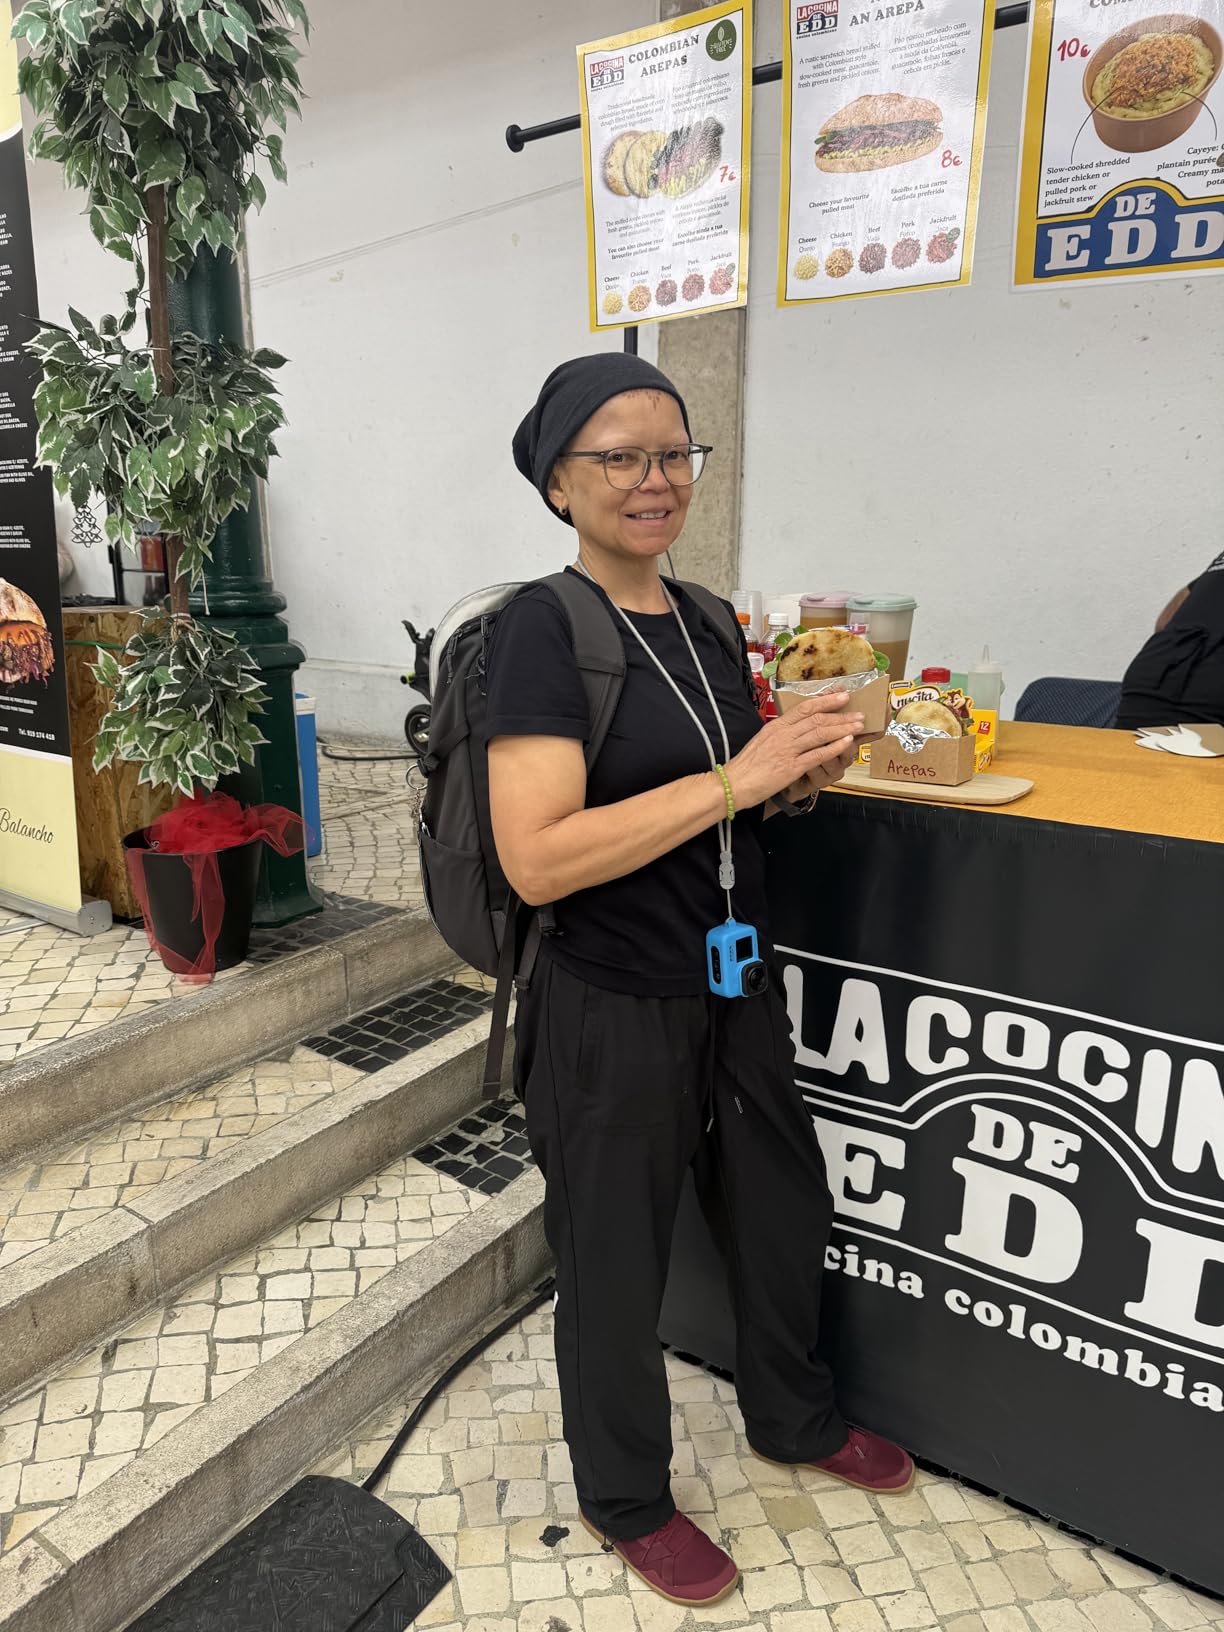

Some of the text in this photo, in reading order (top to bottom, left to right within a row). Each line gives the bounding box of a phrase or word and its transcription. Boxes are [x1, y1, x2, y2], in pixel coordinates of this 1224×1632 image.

[850, 0, 924, 27] AN AREPA
[629, 35, 699, 63] COLOMBIAN
[641, 55, 688, 77] AREPAS
[1187, 145, 1219, 155] Cayeye:
[1047, 157, 1131, 174] Slow-cooked shredded
[1157, 160, 1191, 171] plantain
[1178, 169, 1209, 179] Creamy
[931, 180, 948, 188] carne
[1047, 177, 1069, 185] tender
[1072, 173, 1100, 182] chicken
[918, 188, 945, 199] preferida
[1045, 187, 1068, 197] pulled
[1070, 185, 1087, 194] pork
[830, 198, 843, 206] your
[1044, 195, 1095, 208] jackfruit stew
[1114, 193, 1157, 218] DE
[822, 206, 840, 215] pulled
[799, 236, 817, 244] Cheese
[831, 231, 852, 239] Chicken
[902, 221, 915, 229] Pork
[930, 215, 957, 224] Jackfruit
[1045, 211, 1224, 271] EDD
[897, 691, 934, 708] nucita
[980, 722, 989, 731] 12
[888, 760, 936, 778] Arepas
[0, 808, 54, 844] Balancho
[968, 1104, 1083, 1184] DE
[944, 1288, 1224, 1412] colombia
